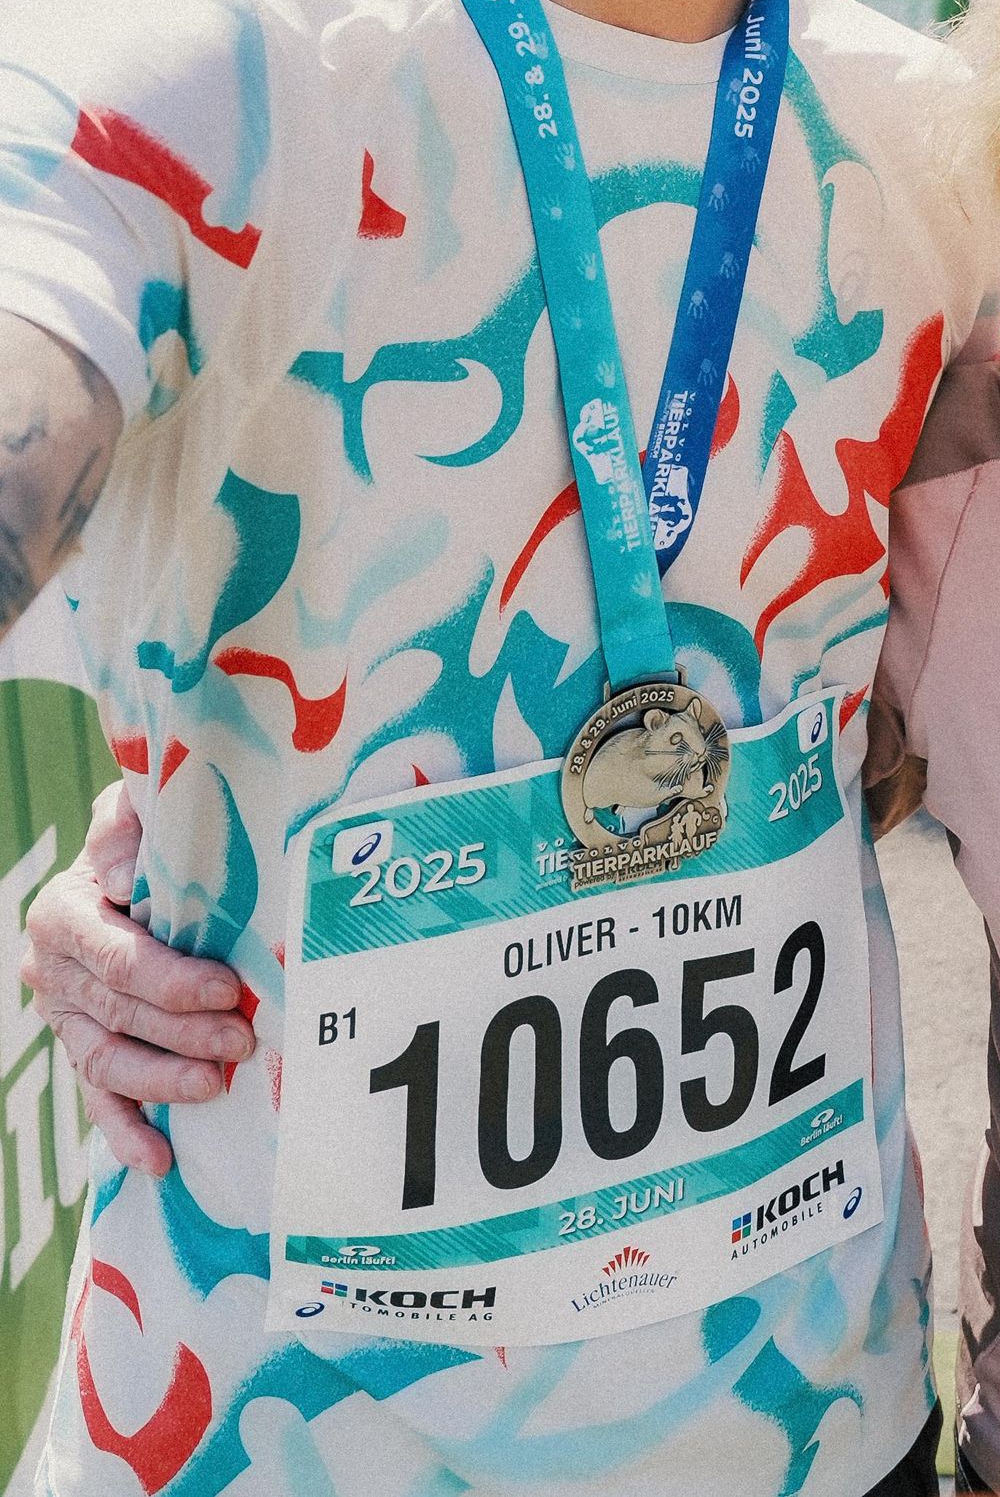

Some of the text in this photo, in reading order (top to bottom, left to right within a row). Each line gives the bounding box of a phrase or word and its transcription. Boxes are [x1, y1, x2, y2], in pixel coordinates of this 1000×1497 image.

[507, 12, 538, 58] 29.
[744, 14, 768, 61] Juni
[524, 64, 546, 86] &
[533, 93, 559, 139] 28.
[733, 68, 764, 139] 2025
[648, 390, 688, 541] TIERPARKLA
[570, 690, 676, 776] 28. & 29. Juni 2025
[767, 753, 823, 824] 2025
[573, 837, 643, 862] VOLVO
[573, 831, 720, 881] TIERPARKLAUF
[348, 841, 489, 908] 2025
[503, 916, 617, 979] OLIVER
[650, 894, 745, 941] 10KM
[317, 1006, 360, 1047] B1
[369, 920, 828, 1212] 10652
[801, 1127, 823, 1147] Berlin
[557, 1176, 685, 1237] 28. JUNI
[756, 1158, 846, 1233] KOCH
[730, 1202, 824, 1261] AUTOMOBILE
[320, 1254, 359, 1266] Berlin
[349, 1301, 494, 1322] TOMOBILE AG
[355, 1286, 497, 1310] KOCH
[570, 1271, 678, 1314] Lichtenauer
